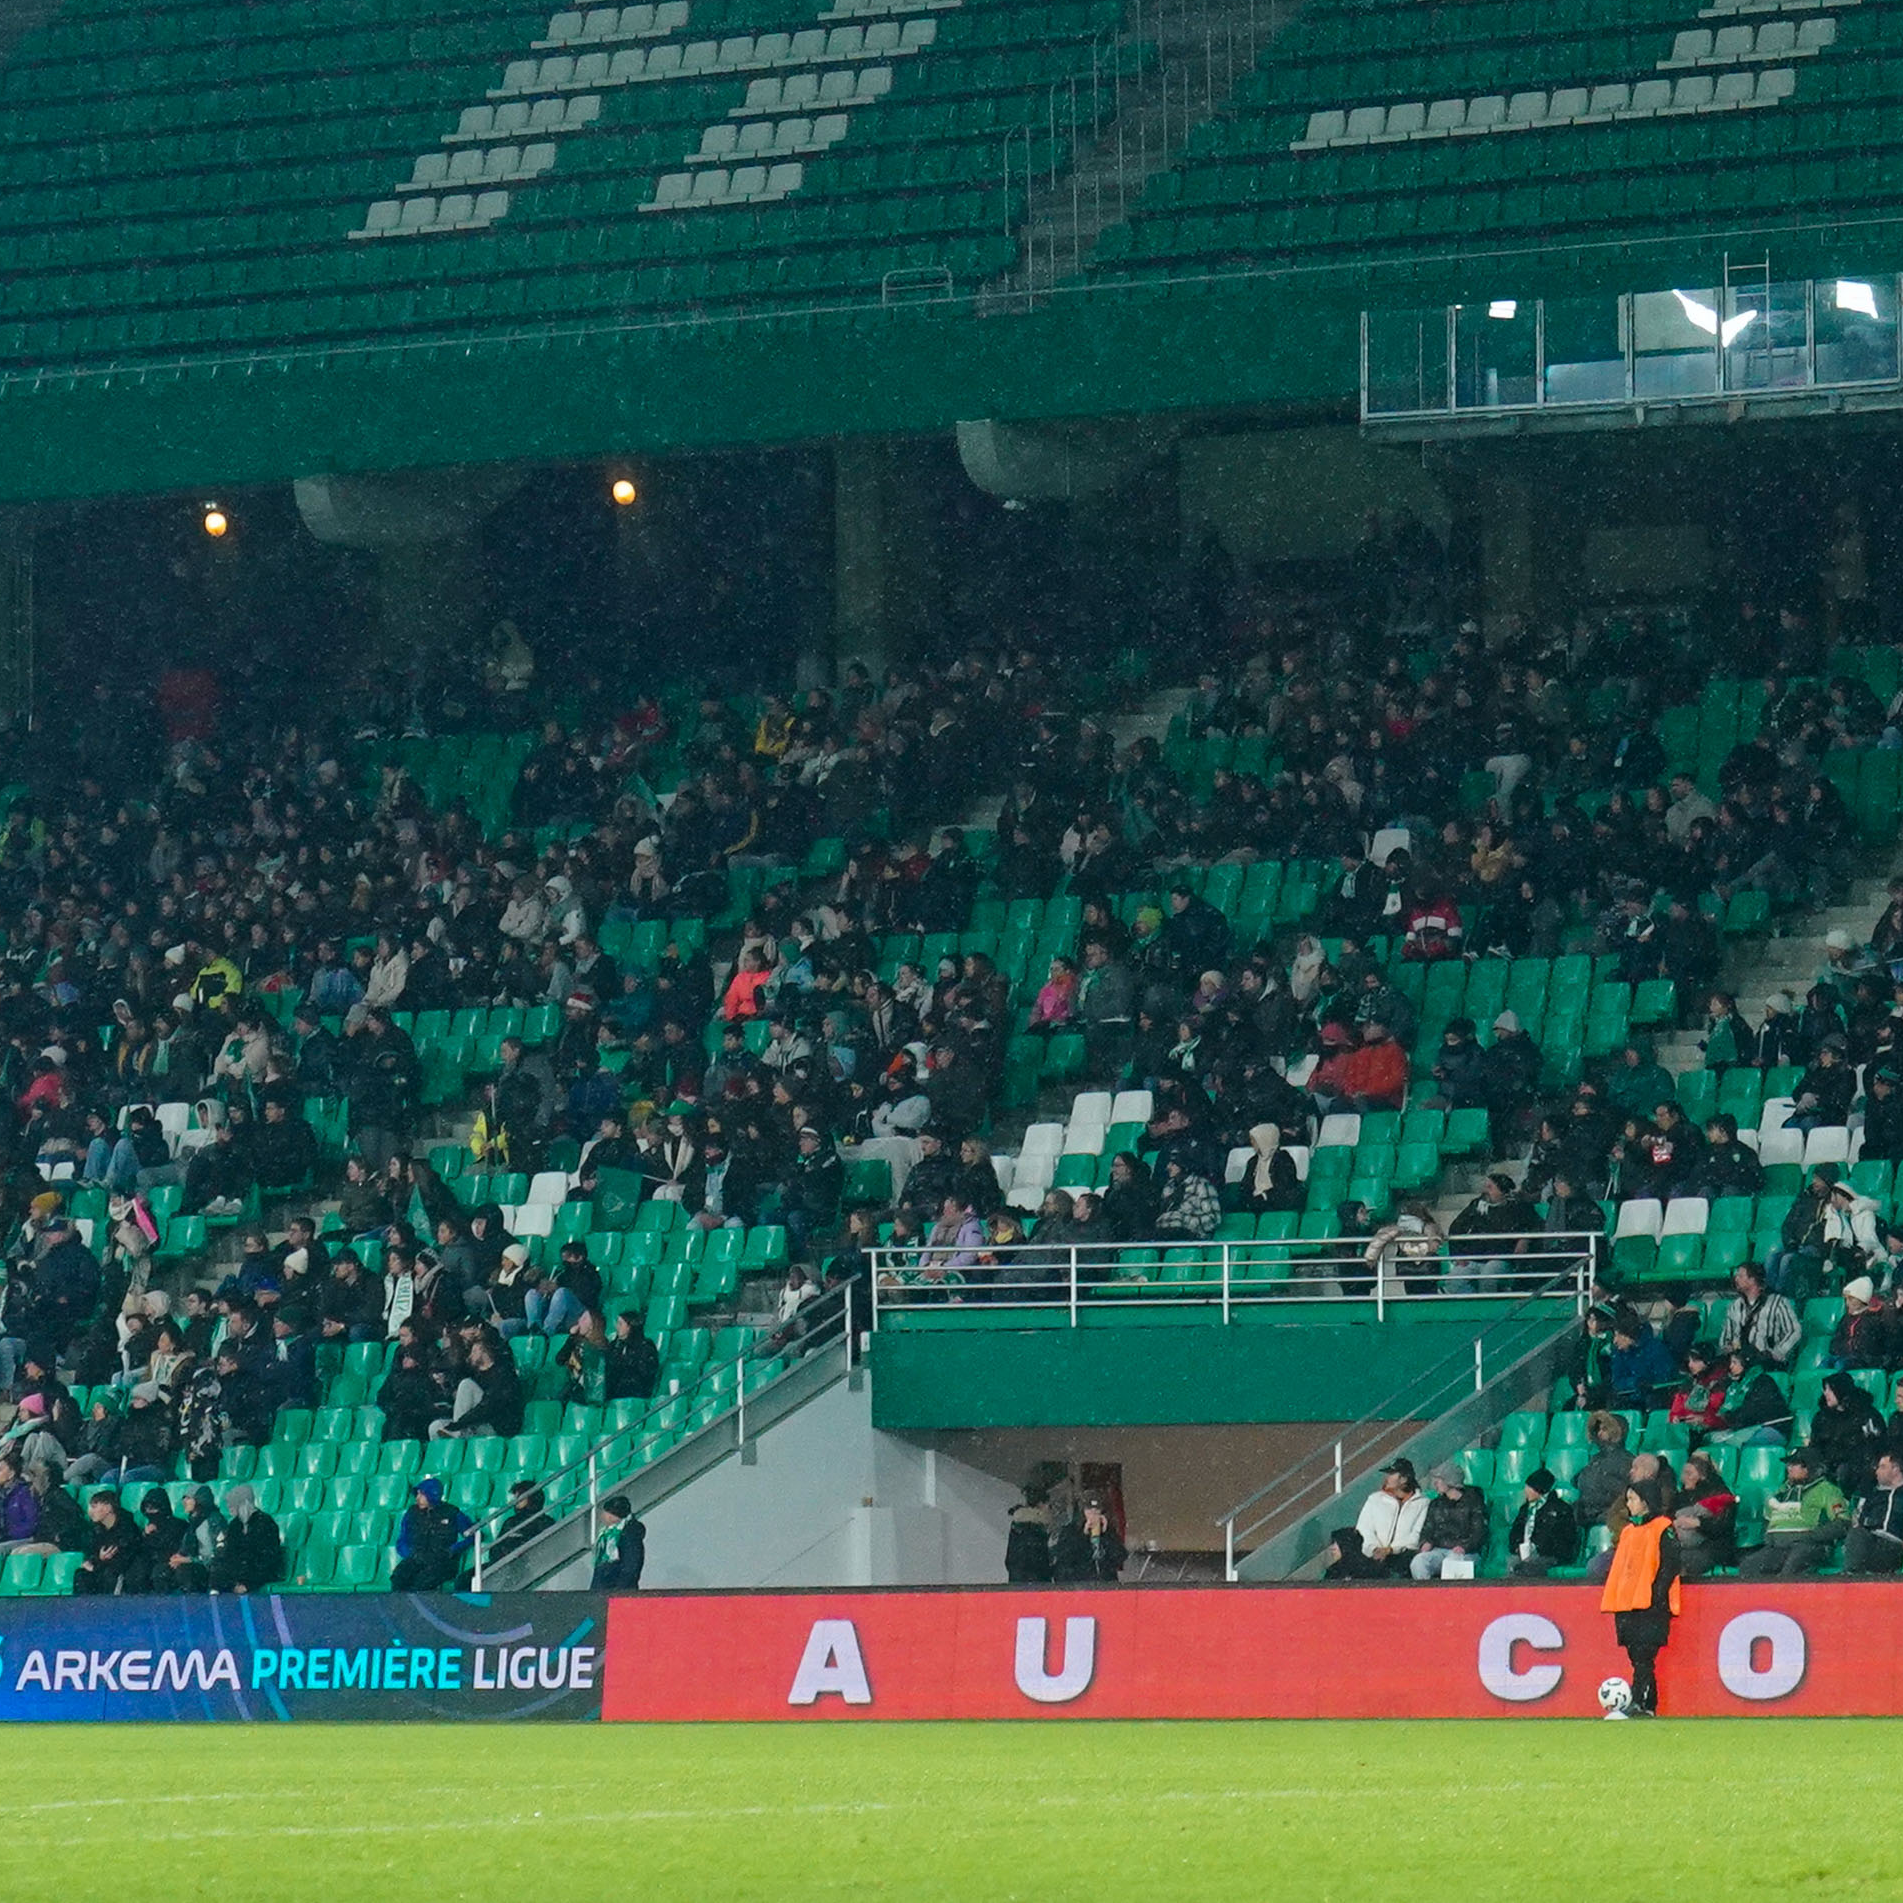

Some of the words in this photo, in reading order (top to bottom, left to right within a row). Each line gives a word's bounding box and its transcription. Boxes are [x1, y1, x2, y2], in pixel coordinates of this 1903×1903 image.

[15, 1648, 241, 1692] ARKEMA
[251, 1639, 462, 1691] PREMIÈRE
[473, 1646, 595, 1690] LIGUE
[785, 1616, 1098, 1706] AU
